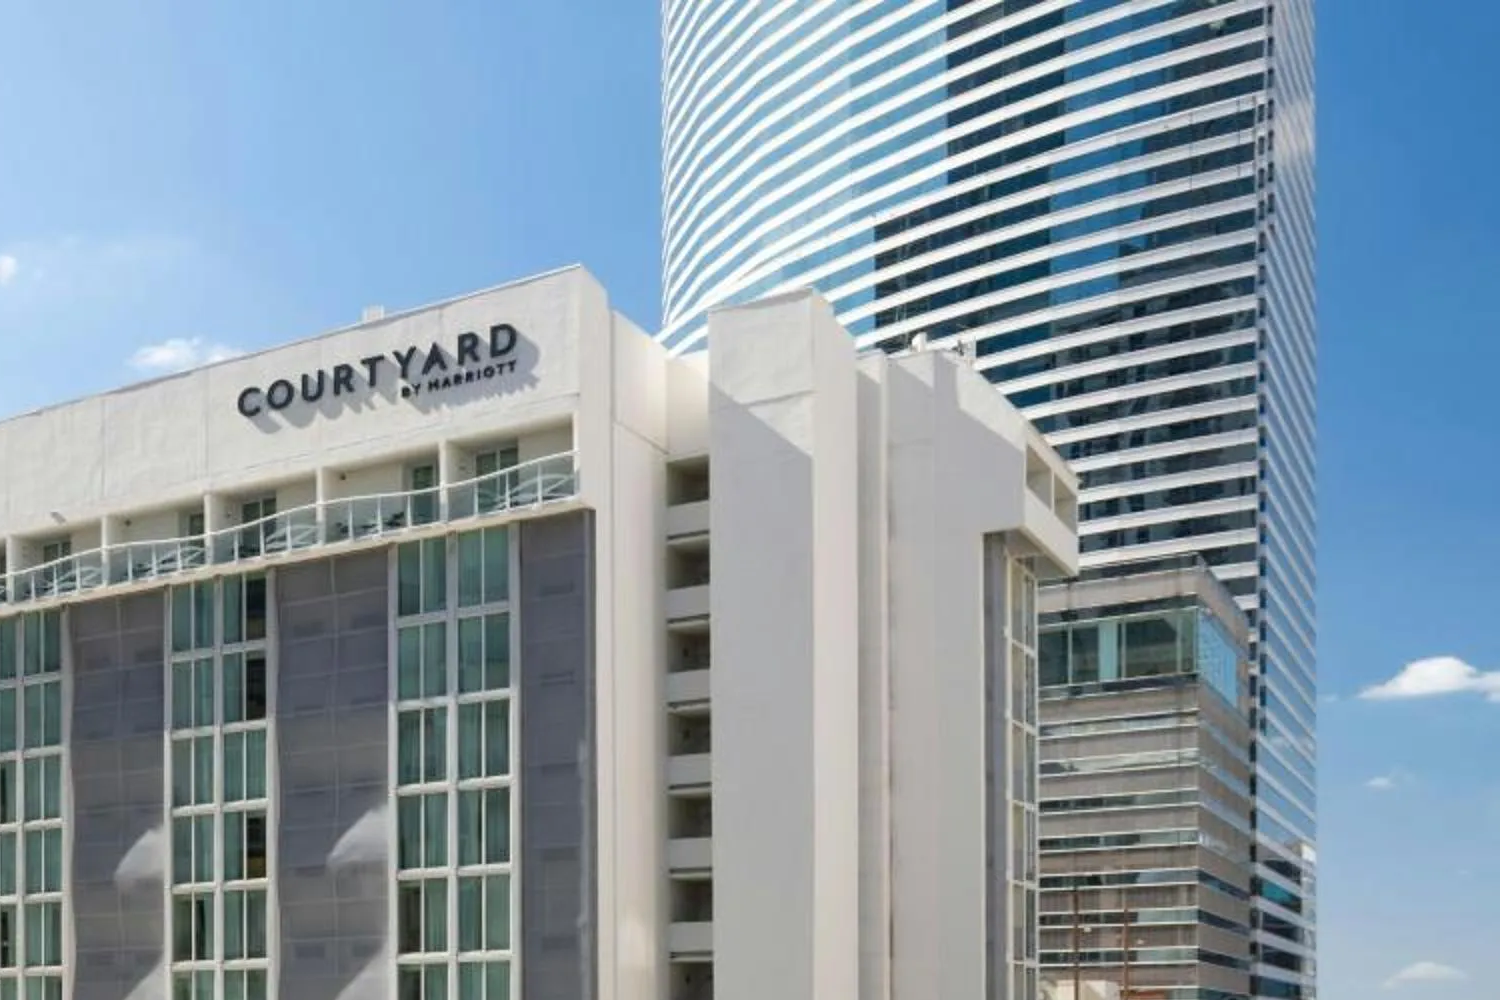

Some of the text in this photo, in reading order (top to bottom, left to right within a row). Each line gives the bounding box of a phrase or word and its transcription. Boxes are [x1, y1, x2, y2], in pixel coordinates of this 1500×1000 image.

[237, 323, 517, 417] COURTYARD
[402, 359, 517, 399] BY MARRIOTT
